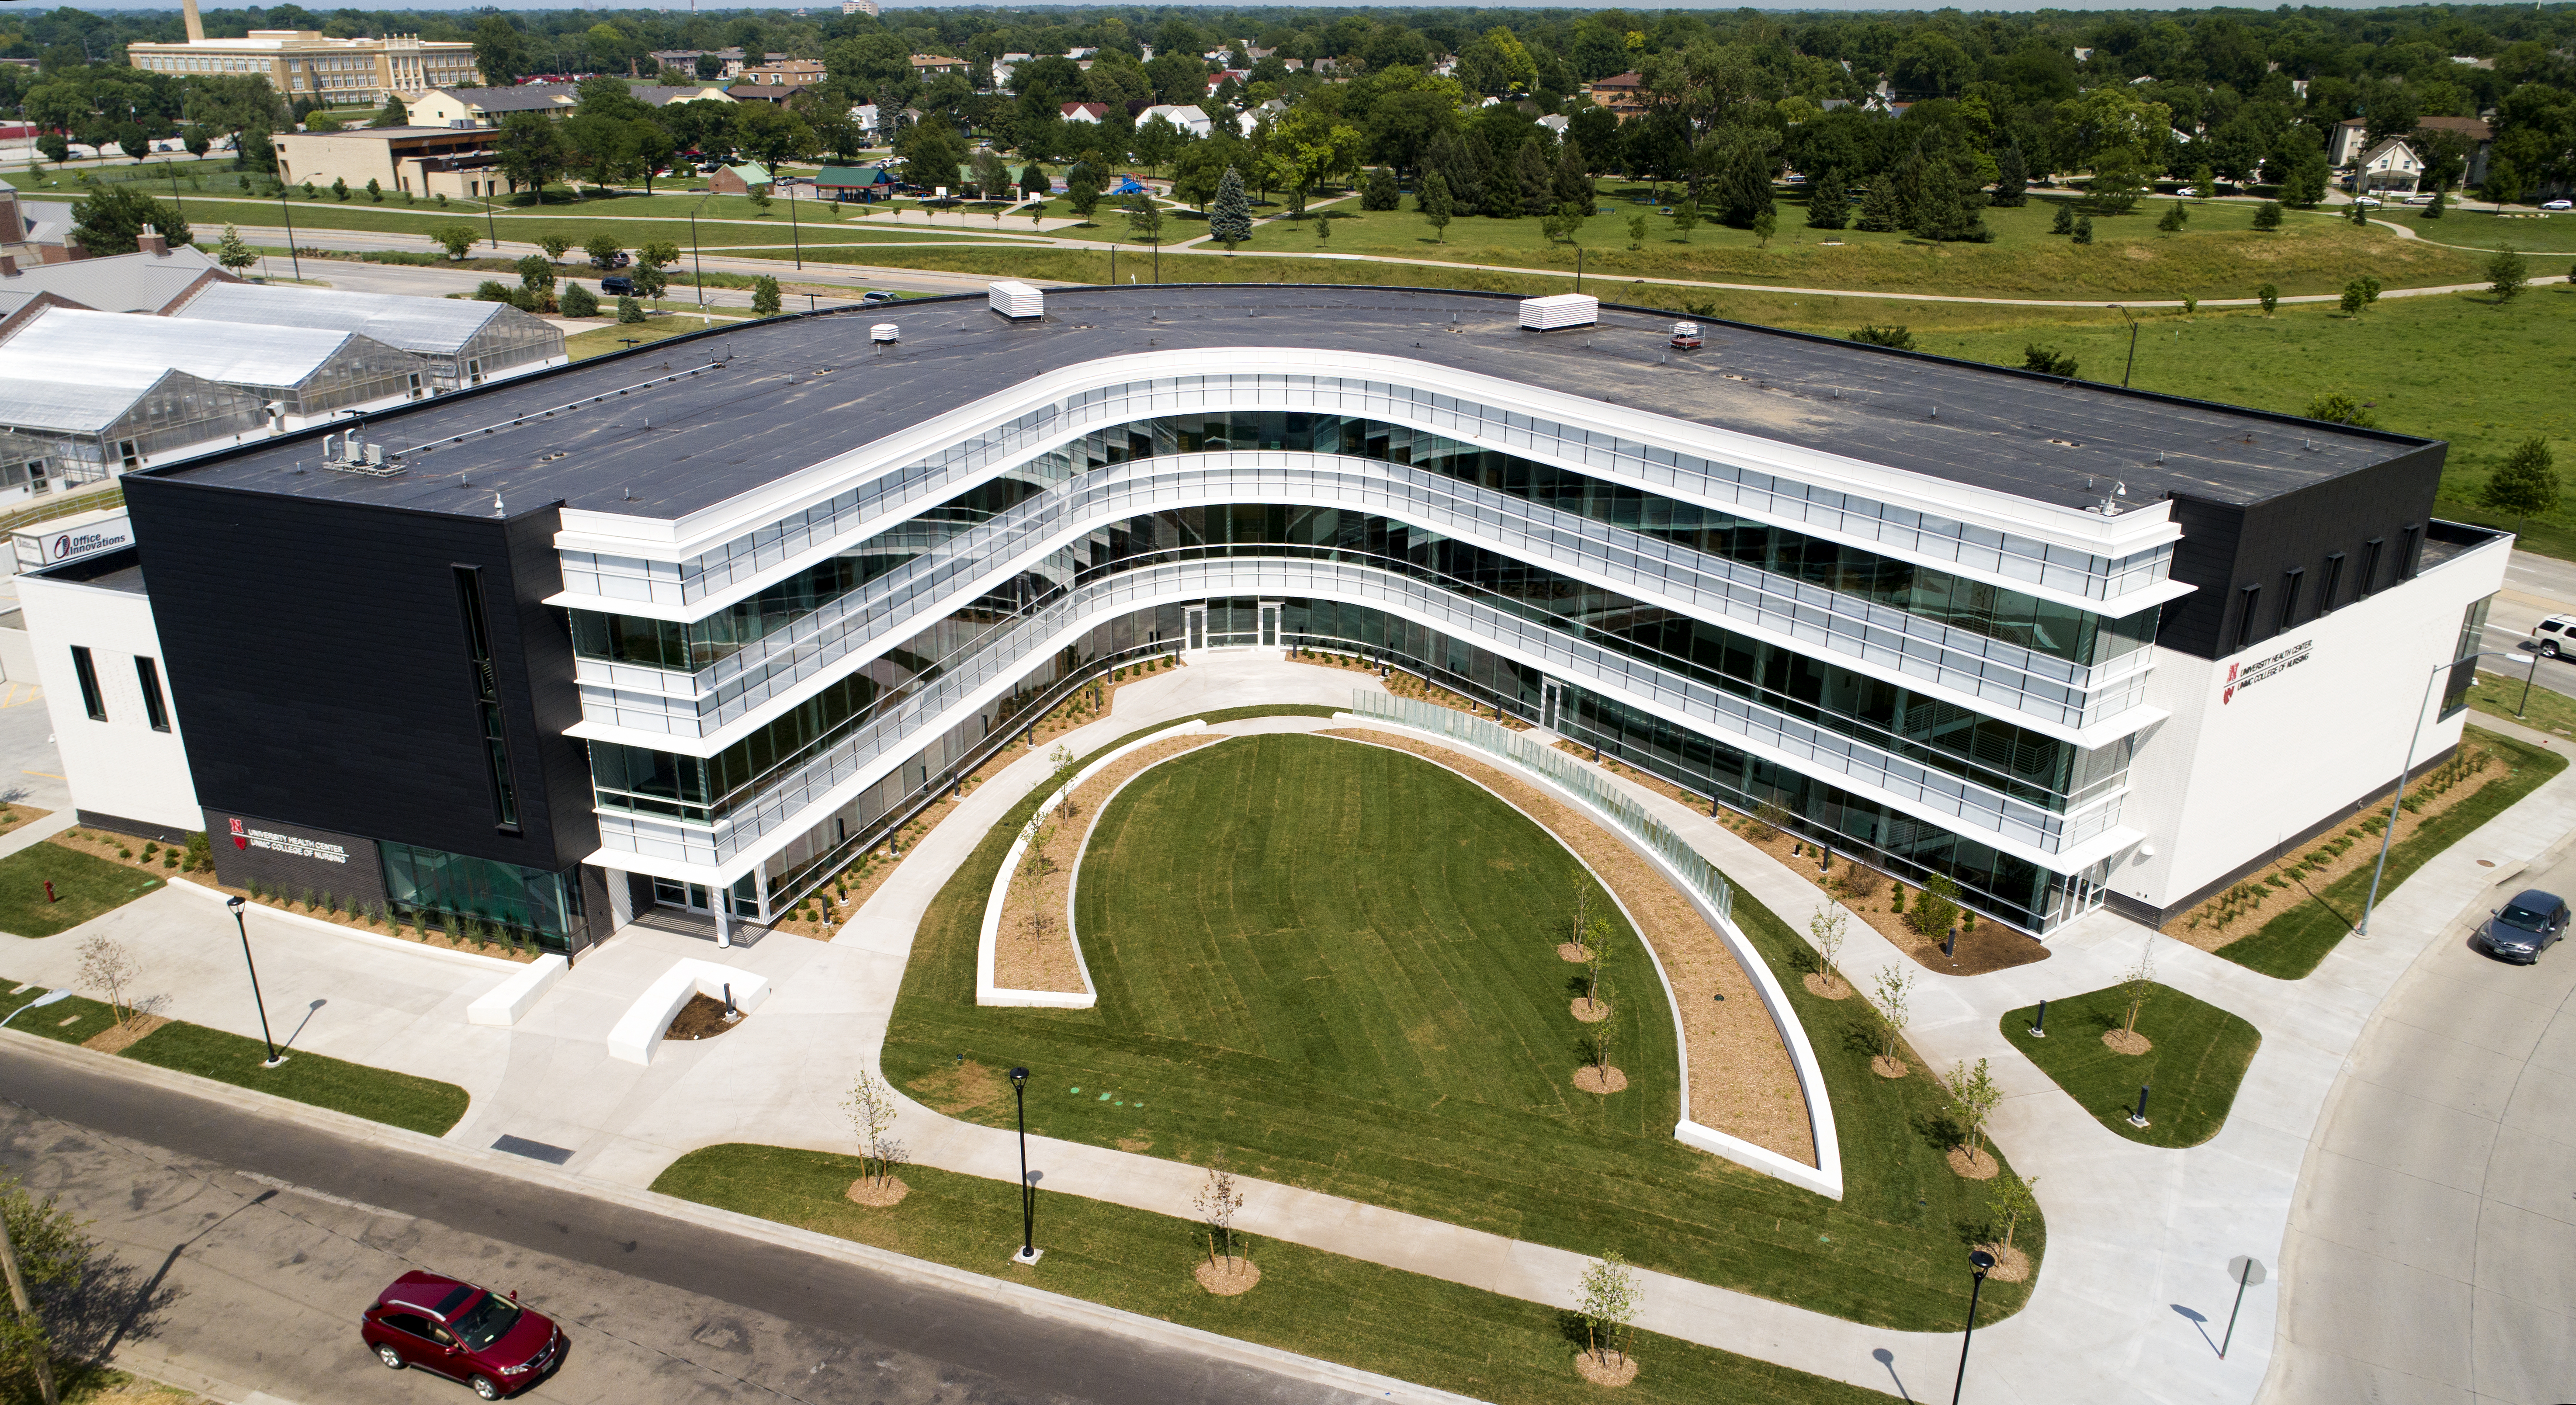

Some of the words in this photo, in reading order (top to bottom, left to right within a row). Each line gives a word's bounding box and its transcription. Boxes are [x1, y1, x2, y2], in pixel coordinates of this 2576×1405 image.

[70, 535, 125, 555] Innovations
[73, 534, 101, 546] Office
[2240, 657, 2271, 677] UNIVERSITY
[2271, 649, 2292, 663] HEALTH
[2292, 639, 2312, 655] CENTER
[2237, 677, 2254, 691] UNMC
[2254, 666, 2278, 683] COLLEGE
[2278, 662, 2287, 673] OF
[2287, 652, 2309, 668] NURSING
[248, 829, 287, 842] UNIVERSITY
[288, 836, 315, 847] HEALTH
[315, 842, 344, 853] CENTER
[250, 838, 271, 849] UNMC
[271, 843, 303, 855] COLLEGE
[314, 851, 346, 864] NURSING
